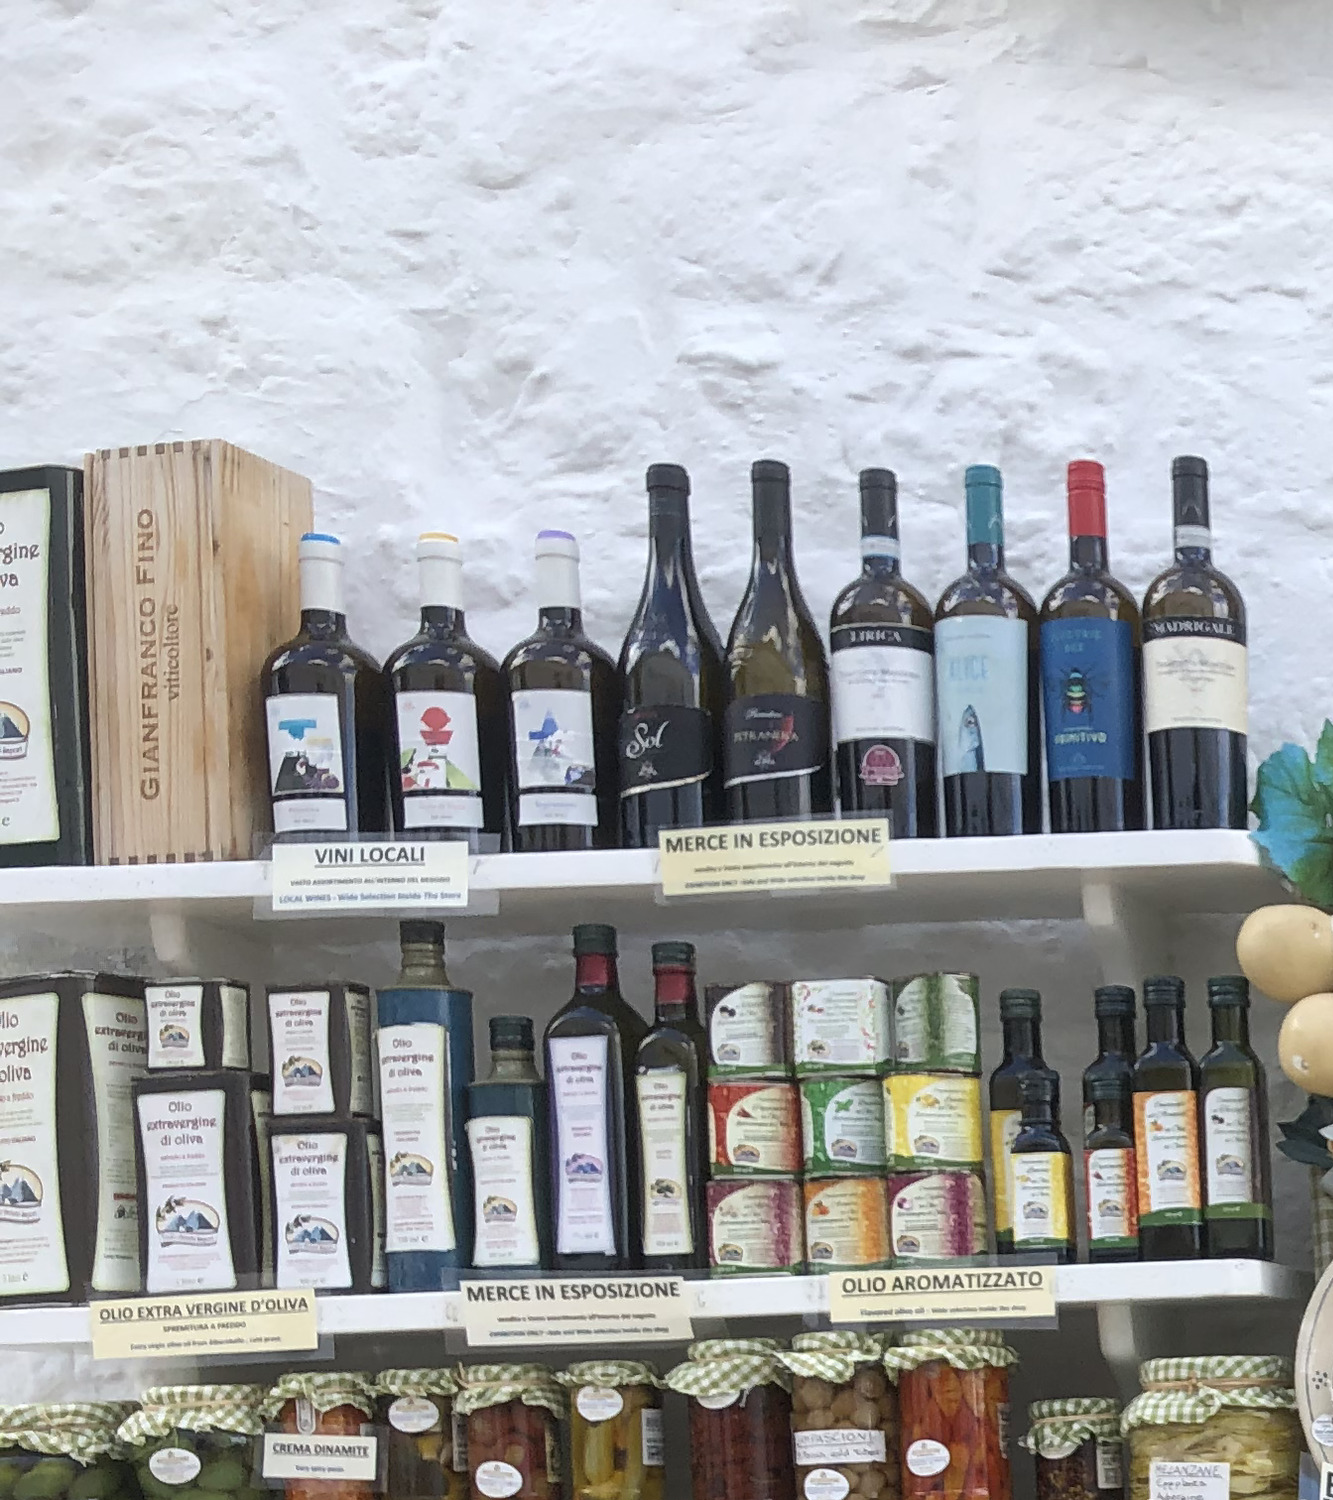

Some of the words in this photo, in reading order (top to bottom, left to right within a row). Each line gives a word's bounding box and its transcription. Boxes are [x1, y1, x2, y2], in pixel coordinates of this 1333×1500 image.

[135, 508, 156, 585] FINO
[164, 604, 180, 702] viticoltore
[140, 597, 159, 801] GIANFRANCO
[666, 834, 728, 853] MERCE
[734, 833, 753, 849] IN
[759, 827, 881, 847] ESPOSIZIONE
[315, 847, 353, 864] VINI
[361, 847, 425, 863] LOCALI
[168, 1101, 192, 1112] Olio
[467, 1285, 530, 1302] MERCE
[536, 1285, 555, 1300] IN
[560, 1282, 680, 1299] ESPOSIZIONE
[842, 1277, 886, 1293] OLIO
[892, 1271, 1043, 1292] AROMATIZZATO
[100, 1307, 134, 1322] OLIO
[137, 1304, 183, 1319] EXTRA
[187, 1300, 247, 1317] VERGINE
[251, 1297, 309, 1312] D'OLIVA
[273, 1444, 310, 1455] CREMA
[314, 1444, 369, 1456] DINAMITE
